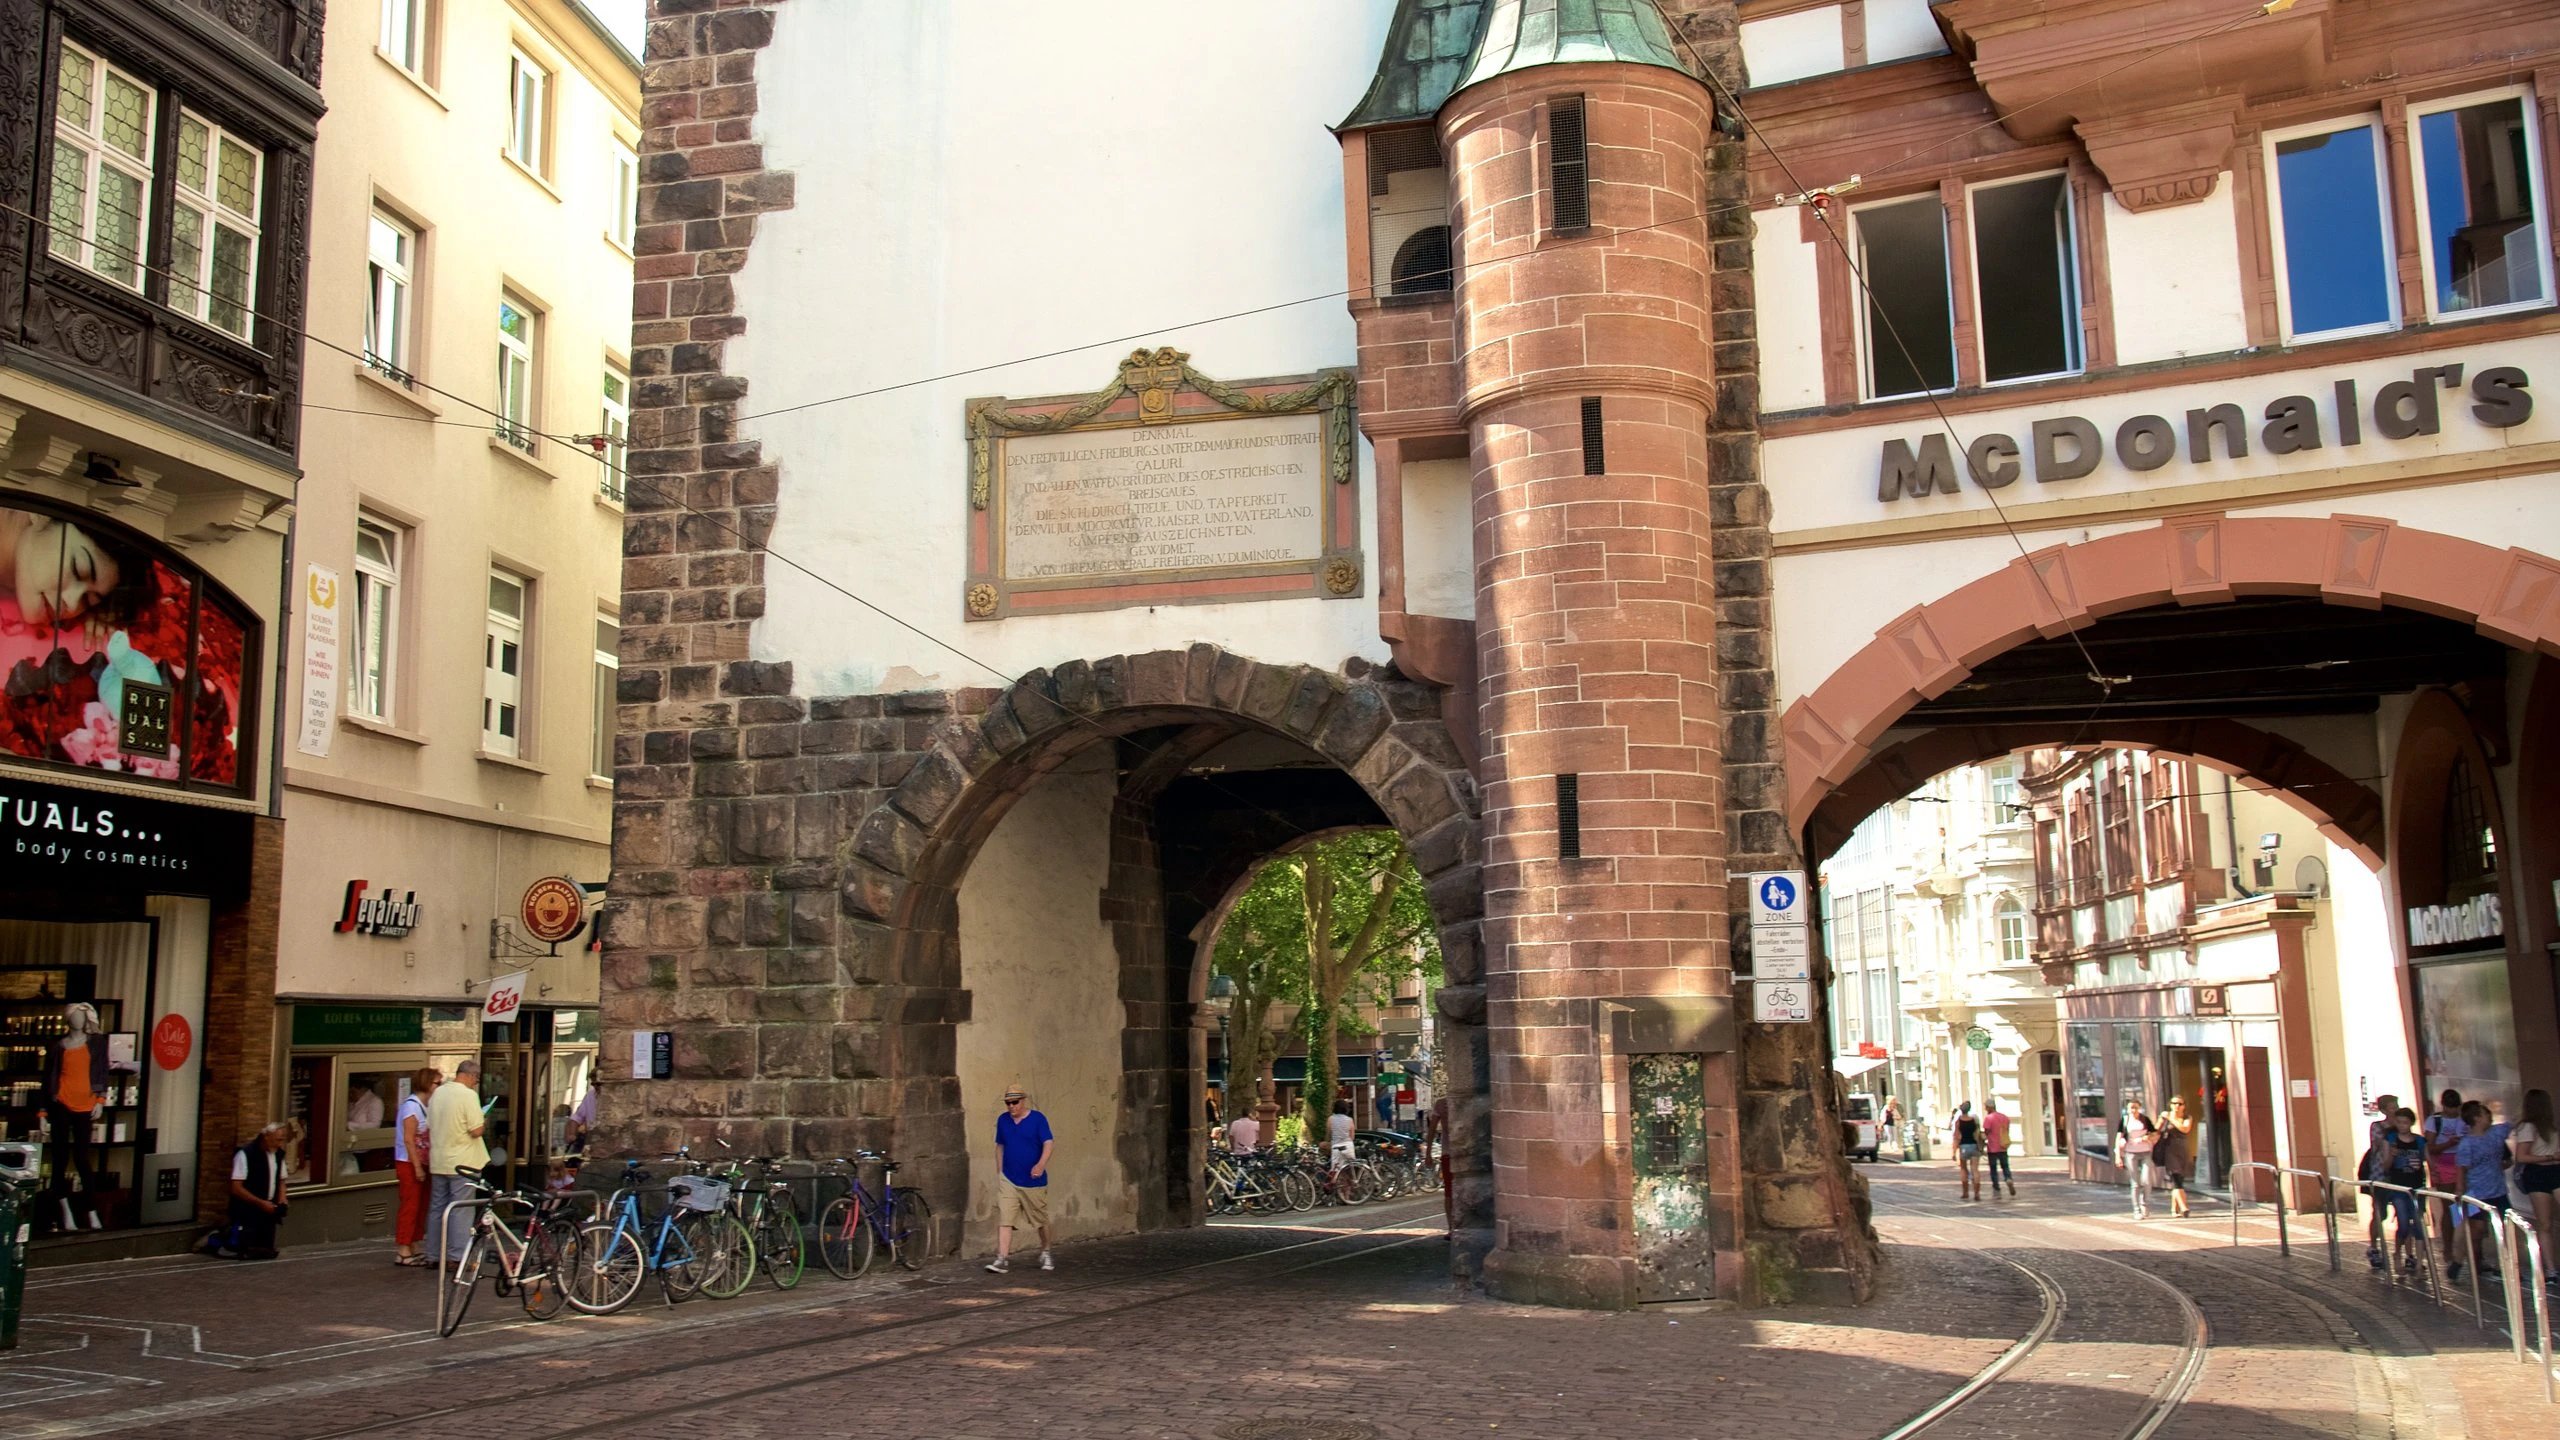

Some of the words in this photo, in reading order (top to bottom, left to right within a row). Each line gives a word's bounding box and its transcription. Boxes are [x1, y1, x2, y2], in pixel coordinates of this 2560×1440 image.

[1878, 362, 2536, 502] McDonald's
[16, 838, 71, 864] body
[84, 848, 188, 870] cosmetics
[336, 879, 424, 934] Segafredo
[528, 884, 553, 907] KOLBEN
[554, 884, 577, 907] KAFFEE
[1765, 912, 1792, 922] ZONE
[2409, 893, 2504, 947] McDonald's
[378, 926, 408, 937] ZANETTI
[487, 987, 520, 1015] Eis
[324, 1012, 362, 1024] KOLBEN
[369, 1012, 402, 1024] KAFFEE
[159, 1022, 186, 1044] Sale
